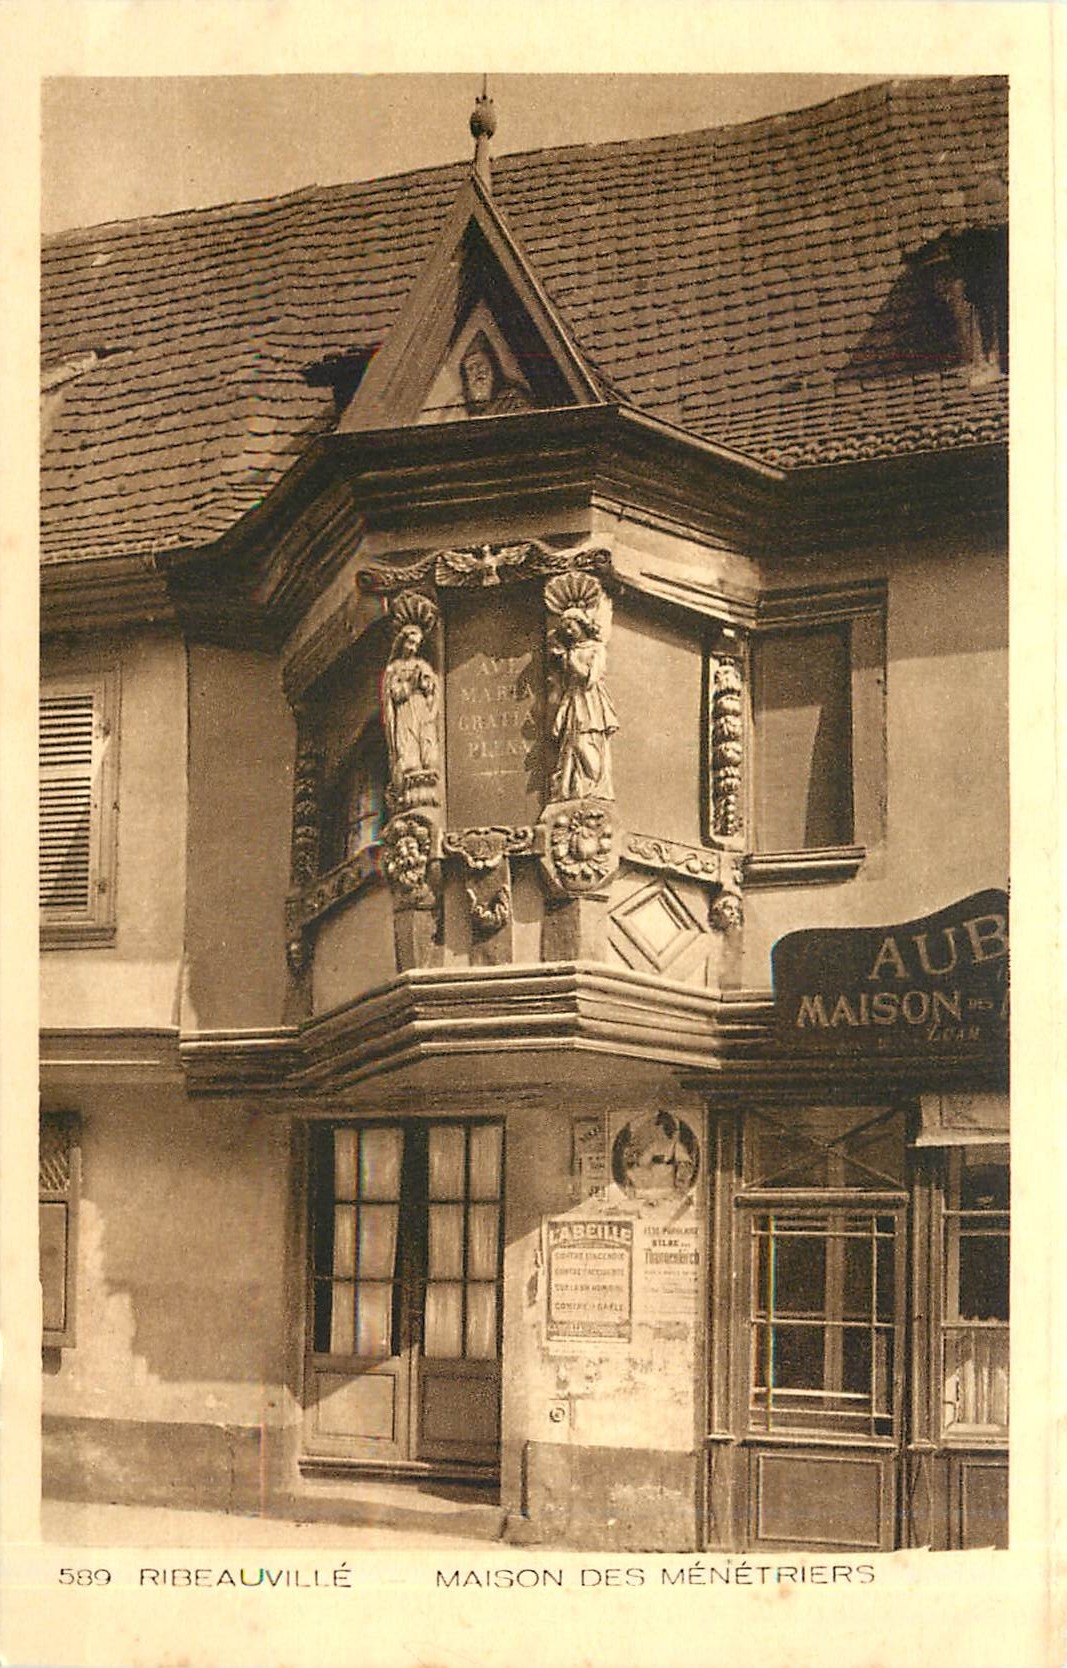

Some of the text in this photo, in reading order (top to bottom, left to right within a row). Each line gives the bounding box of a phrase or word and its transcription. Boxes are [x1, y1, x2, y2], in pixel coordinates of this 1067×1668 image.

[460, 683, 535, 702] MARIA
[459, 711, 536, 731] GRATIA
[796, 990, 963, 1028] MAISON
[548, 1223, 632, 1247] L'ABEILLE
